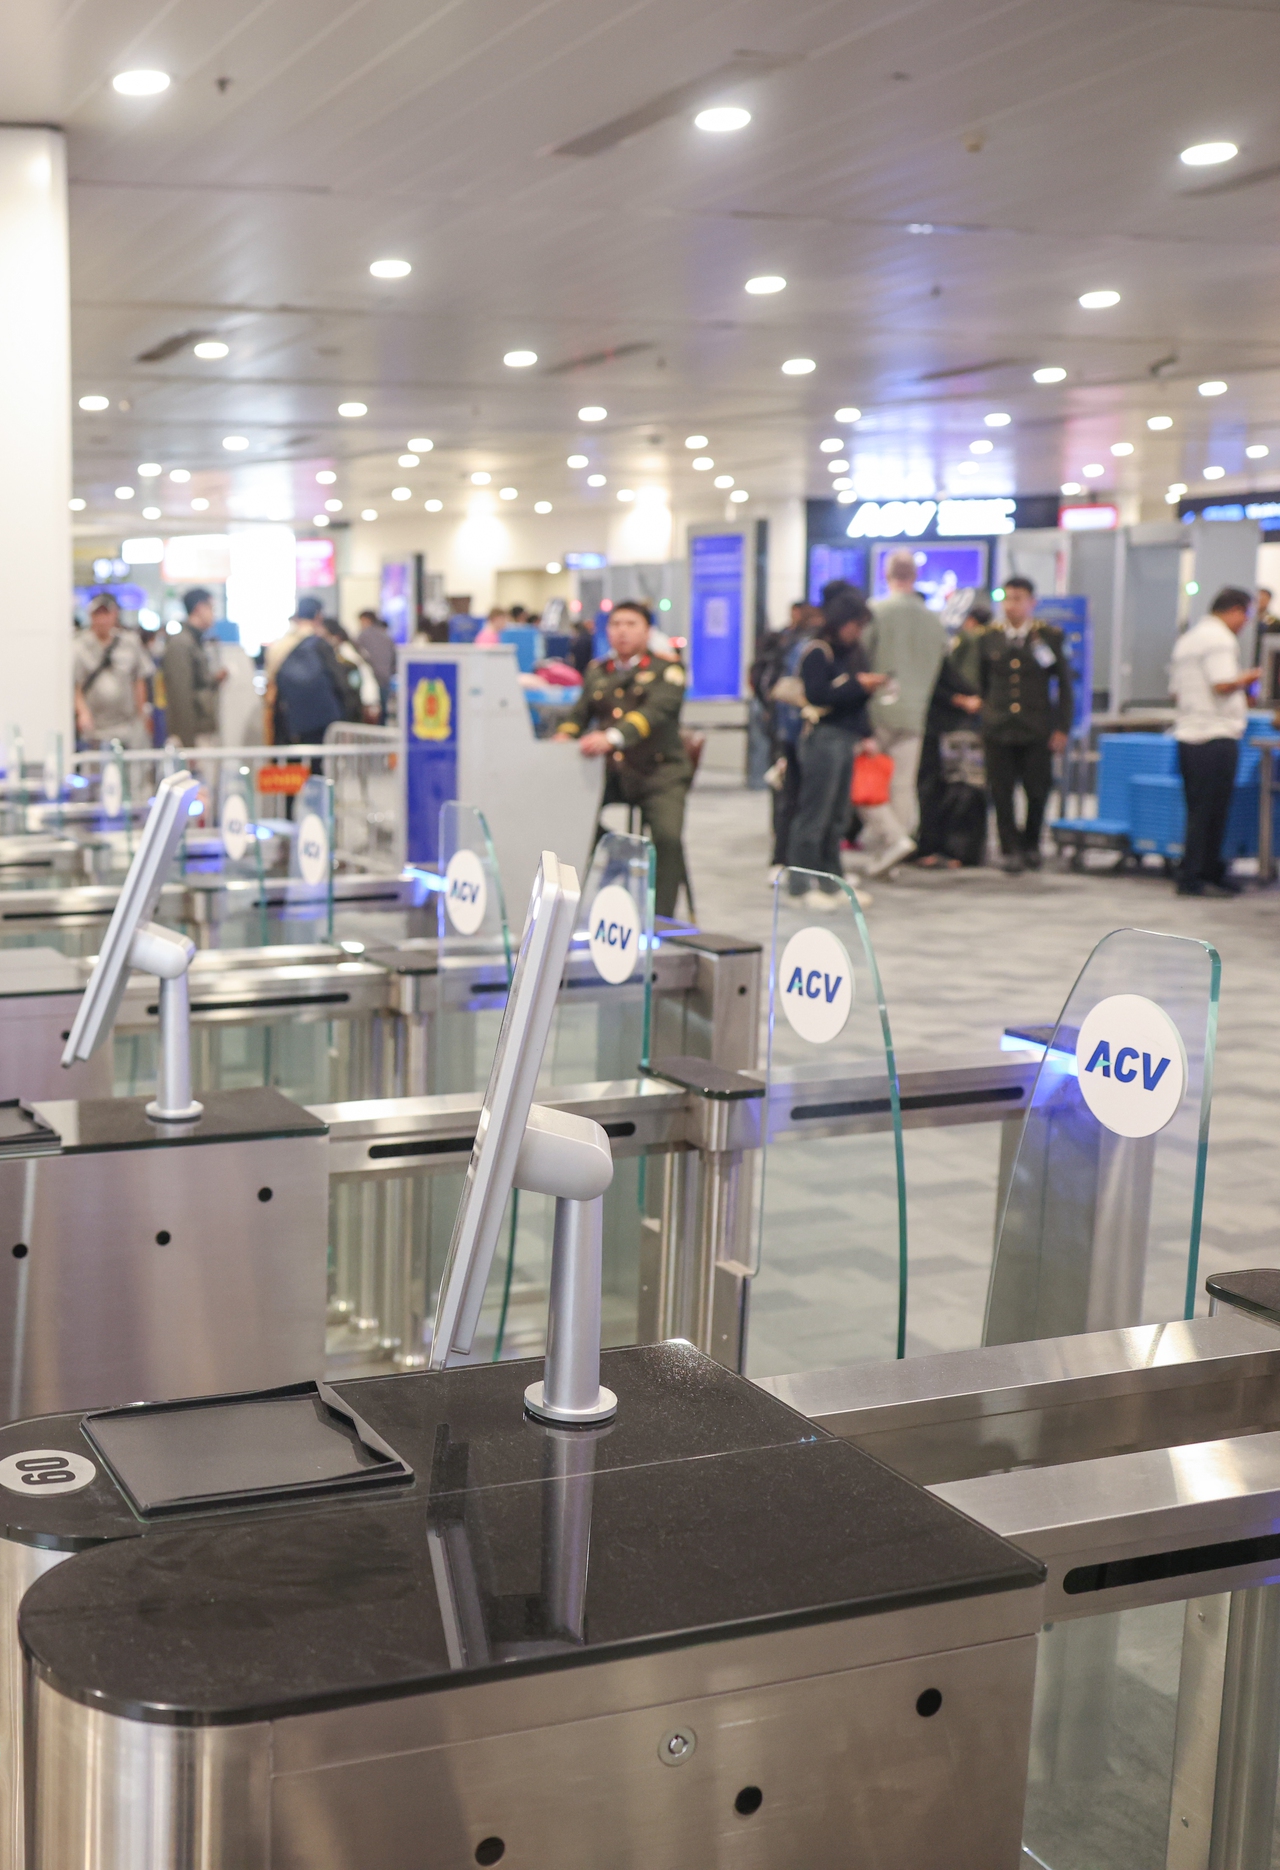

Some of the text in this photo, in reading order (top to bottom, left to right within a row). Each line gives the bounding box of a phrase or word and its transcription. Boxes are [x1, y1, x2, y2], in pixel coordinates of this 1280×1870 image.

[450, 879, 481, 904] ACV
[594, 919, 633, 950] ACV
[786, 966, 842, 1004] ACV
[1084, 1039, 1171, 1092] ACV
